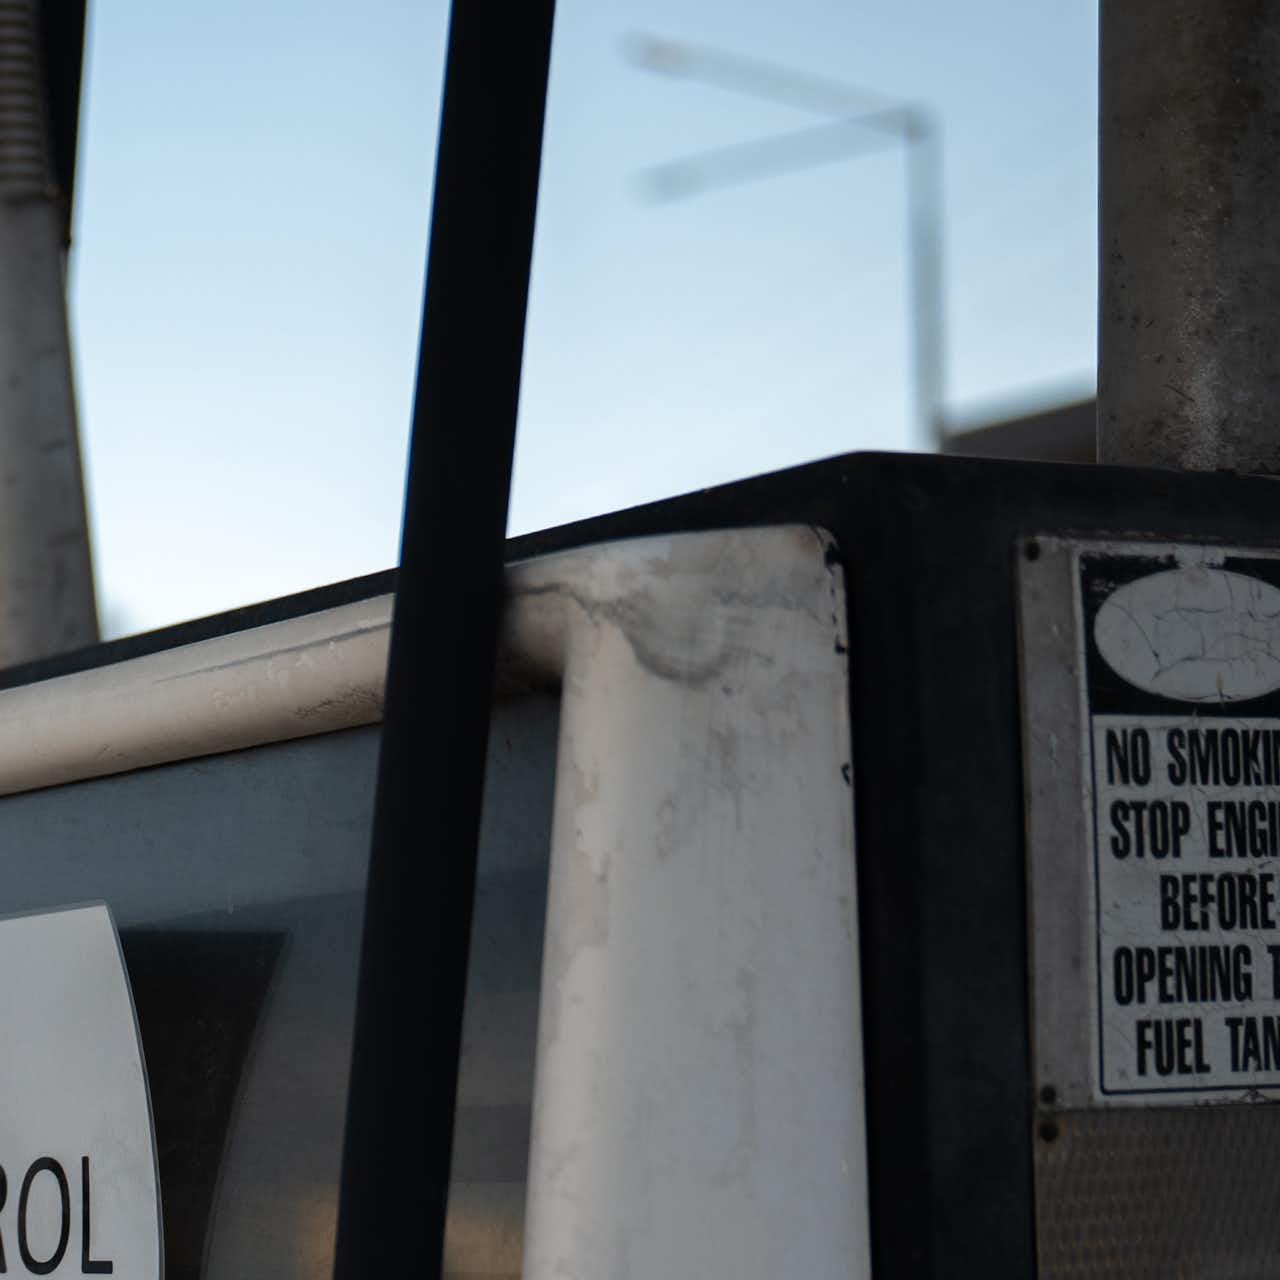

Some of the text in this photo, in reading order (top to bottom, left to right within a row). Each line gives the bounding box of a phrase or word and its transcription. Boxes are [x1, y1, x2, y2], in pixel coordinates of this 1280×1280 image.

[1106, 728, 1151, 786] NO
[1110, 799, 1280, 859] STOP ENGI
[1159, 873, 1276, 932] BEFORE
[1113, 944, 1253, 1006] OPENING
[1136, 1018, 1210, 1076] FUEL
